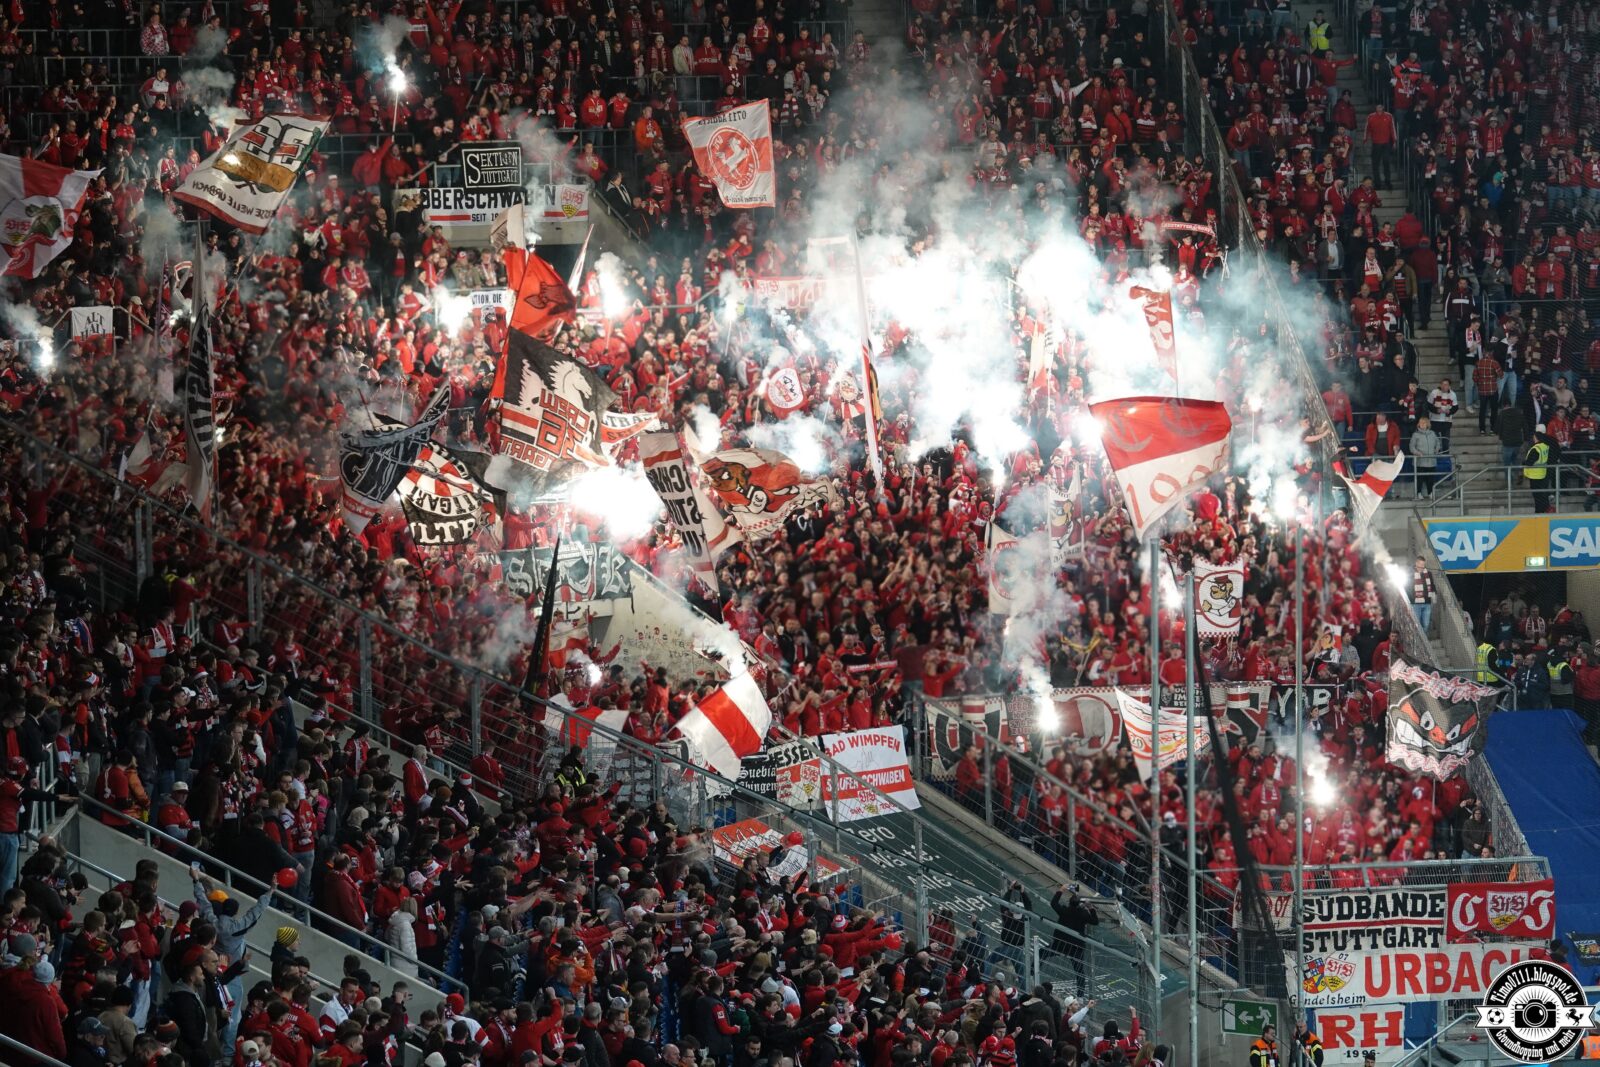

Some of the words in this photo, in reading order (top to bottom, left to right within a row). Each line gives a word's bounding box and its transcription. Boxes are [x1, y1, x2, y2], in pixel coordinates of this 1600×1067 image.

[471, 213, 486, 222] SEIT
[1429, 529, 1497, 562] SAP
[1550, 527, 1600, 559] SA
[825, 739, 846, 758] BAD
[847, 733, 901, 753] WIMPFEN
[1302, 890, 1446, 923] SÜDBANDE
[1302, 926, 1446, 953] STUTTGART
[1289, 994, 1366, 1008] Gndelsheim
[1318, 1010, 1404, 1050] RH
